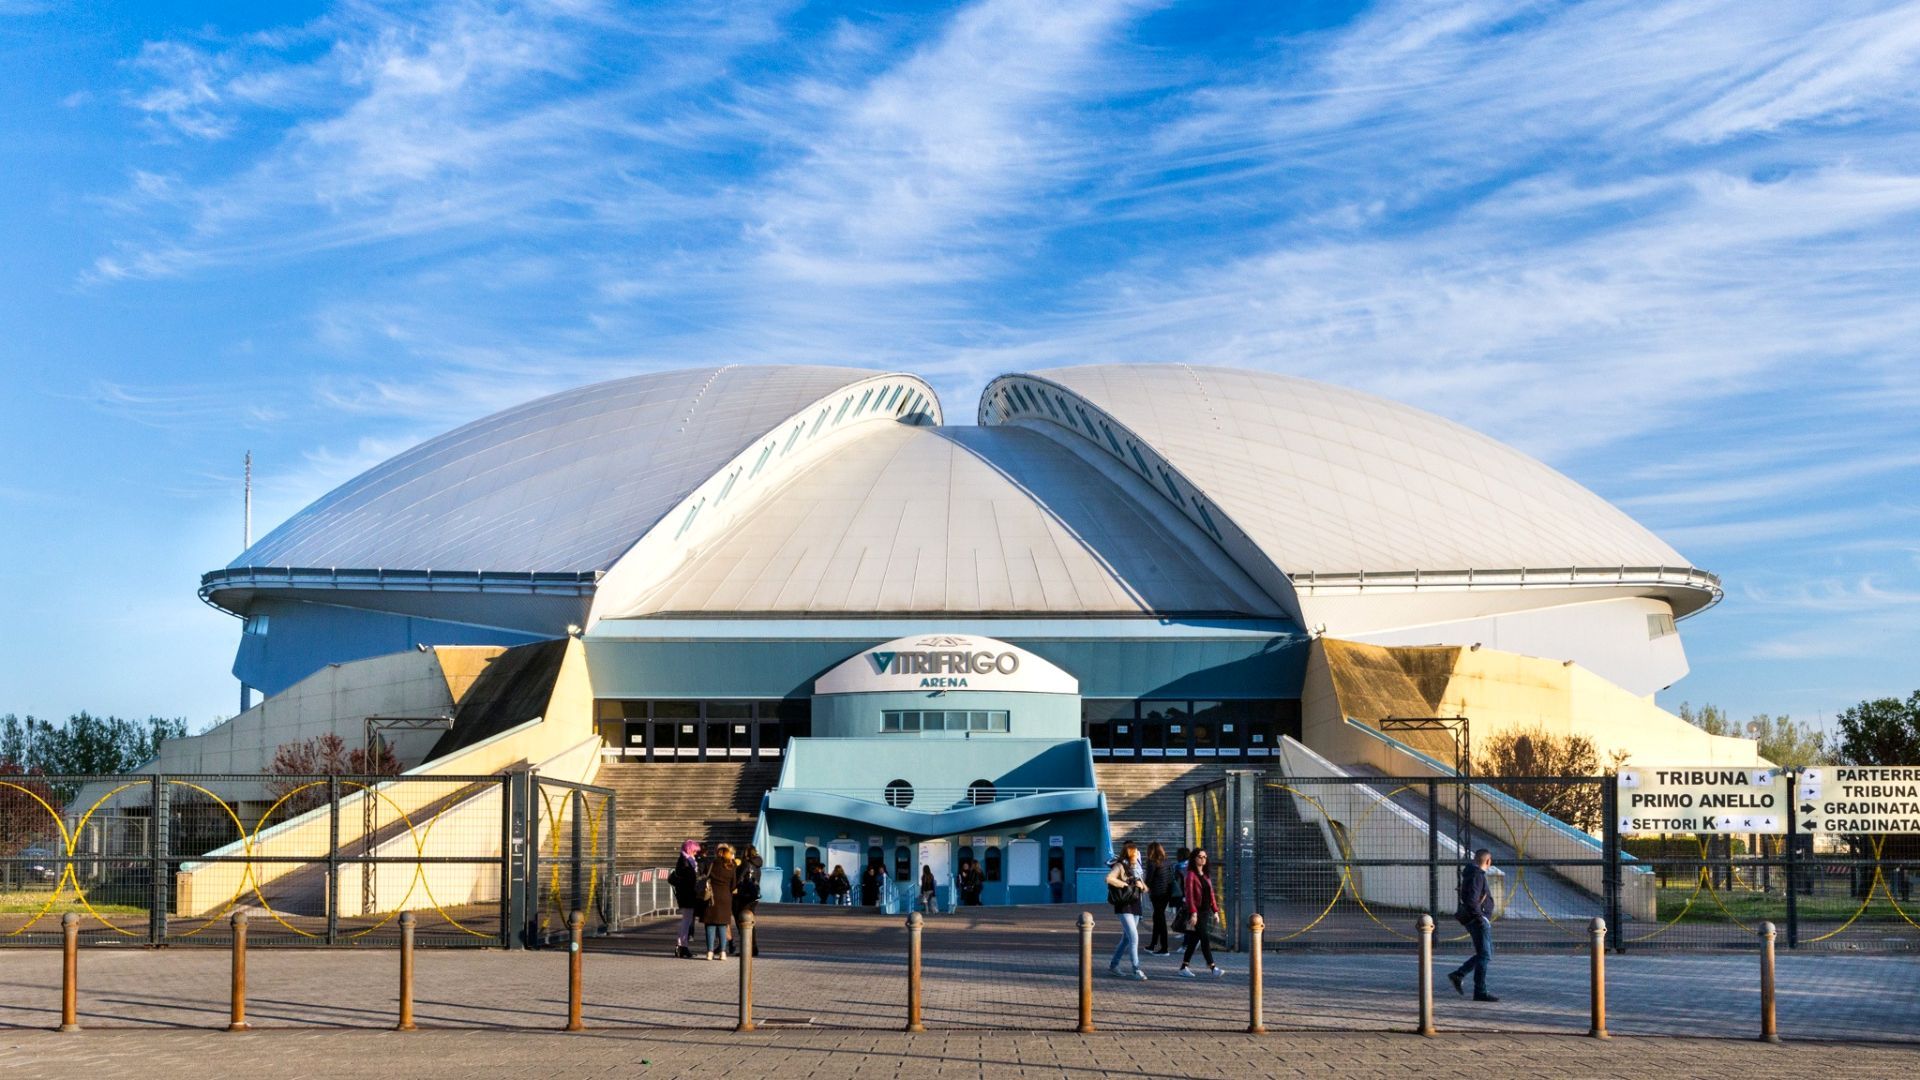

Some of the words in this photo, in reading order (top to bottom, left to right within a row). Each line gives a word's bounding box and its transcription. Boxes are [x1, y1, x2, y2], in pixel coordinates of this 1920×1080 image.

[865, 651, 1020, 675] VITRIFRIGO
[919, 677, 968, 688] ARENA
[1656, 771, 1749, 785] TRIBUNA
[1836, 769, 1920, 781] PARTERRE
[1842, 785, 1918, 798] TRIBUNA
[1631, 793, 1693, 808] PRIMO
[1699, 793, 1775, 808] ANELLO
[1823, 802, 1920, 815] GRADINATA
[1632, 818, 1697, 830] SETTORI
[1743, 819, 1752, 827] K
[1824, 819, 1920, 831] GRADINATA
